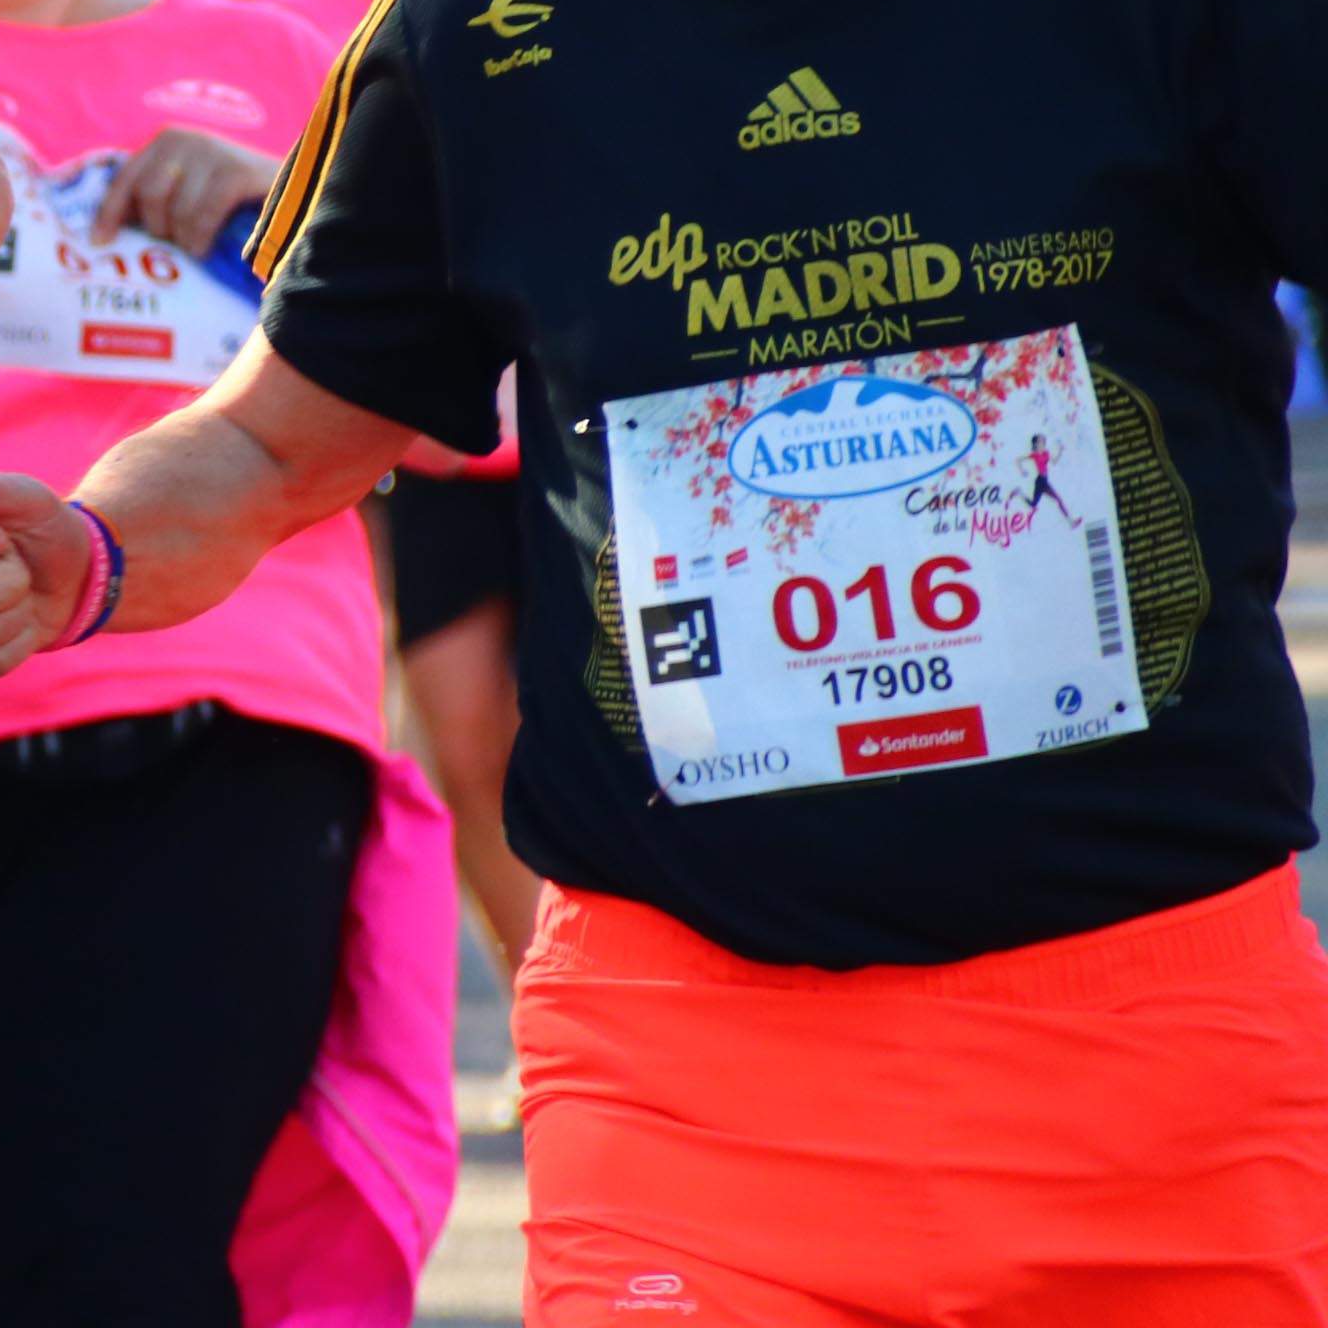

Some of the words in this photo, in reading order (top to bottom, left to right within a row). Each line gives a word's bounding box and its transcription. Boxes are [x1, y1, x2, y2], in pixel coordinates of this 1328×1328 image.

[738, 109, 862, 151] adidas
[608, 211, 708, 292] edp
[969, 227, 1114, 262] ANIVERSARIO
[686, 242, 963, 336] MADRID
[972, 250, 1113, 295] 1978-2017
[748, 312, 912, 366] MARATÓN
[748, 420, 960, 481] ASTURIANA
[904, 482, 1002, 516] Carrera
[969, 505, 1039, 549] Mujer
[772, 552, 982, 653] 016
[821, 655, 954, 707] 17908
[879, 727, 966, 755] Santander
[1036, 715, 1110, 750] ZURICH
[678, 745, 790, 787] OYSHO
